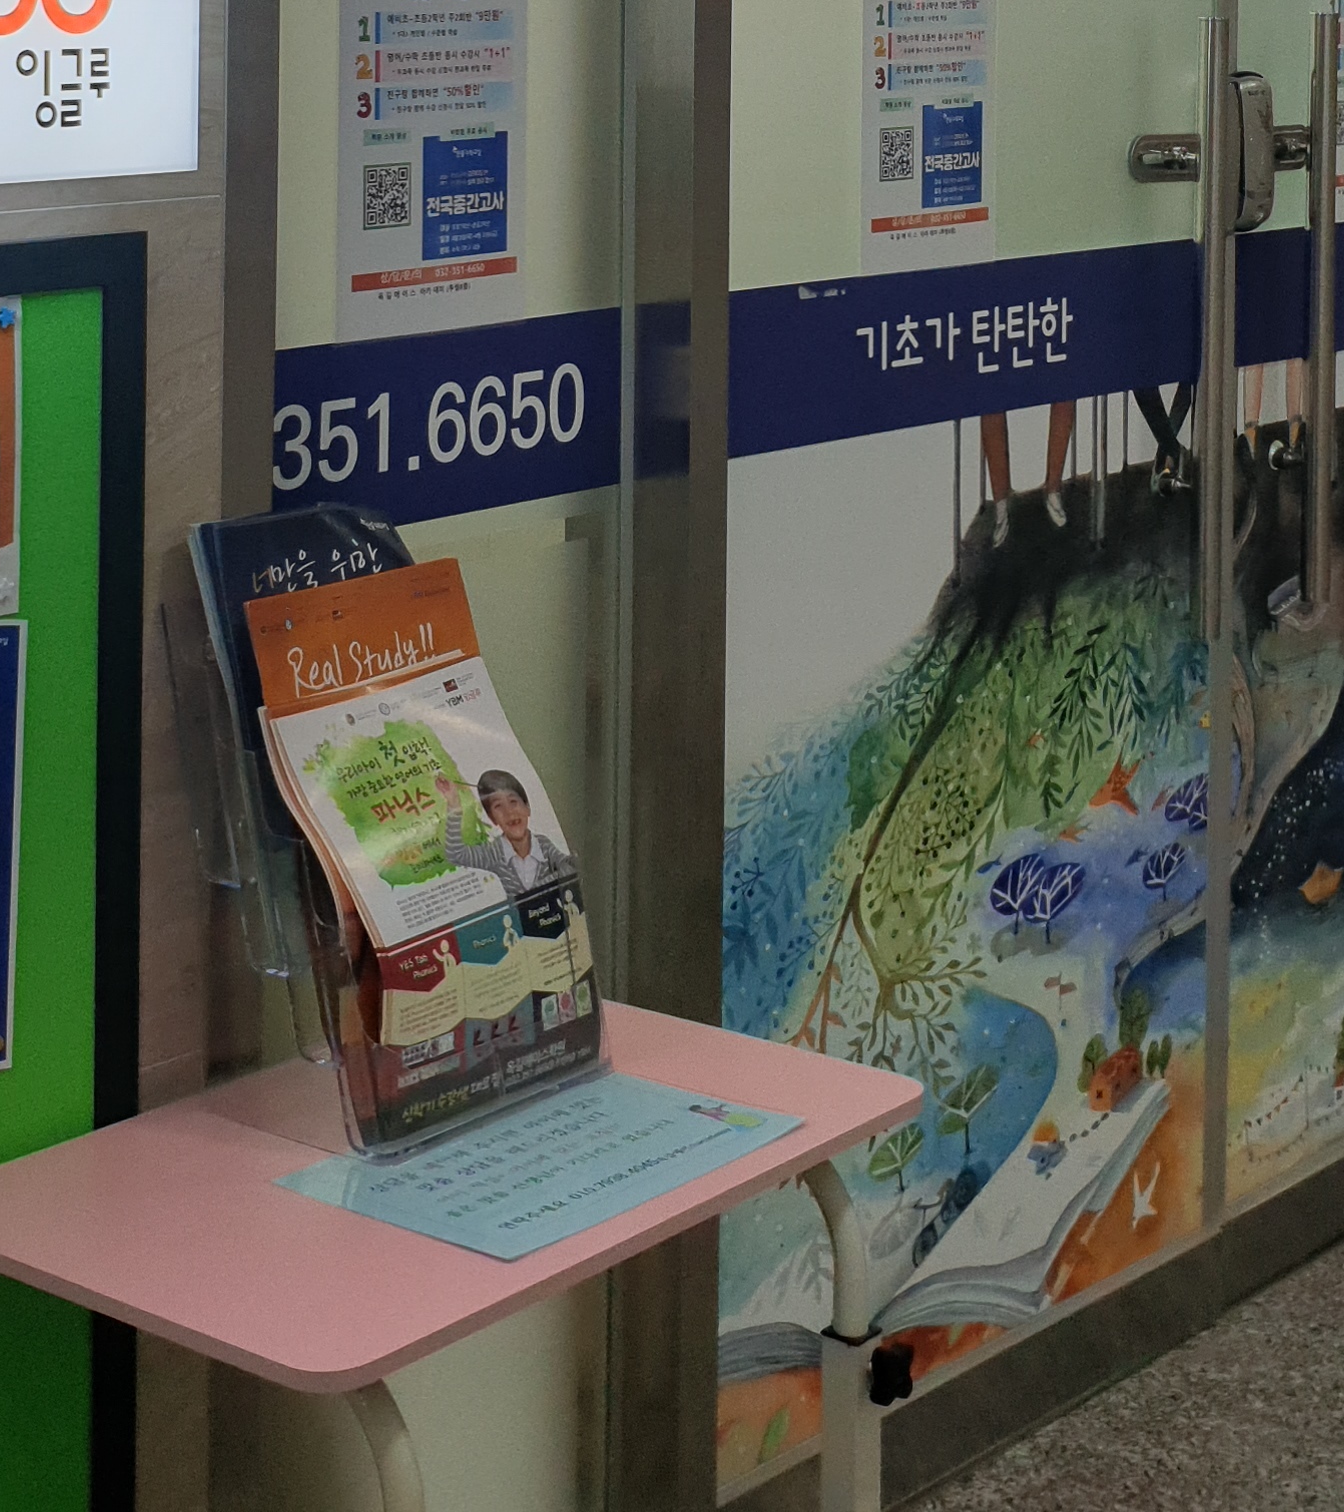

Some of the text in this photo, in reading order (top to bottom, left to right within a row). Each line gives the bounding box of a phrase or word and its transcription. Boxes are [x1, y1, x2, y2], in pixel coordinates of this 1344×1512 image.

[15, 48, 111, 129] 잉글루
[426, 190, 505, 218] 전국중간고사
[856, 296, 1074, 374] 기초가 탄탄한
[288, 622, 435, 699] Real Study!!
[371, 788, 436, 823] 파닉스
